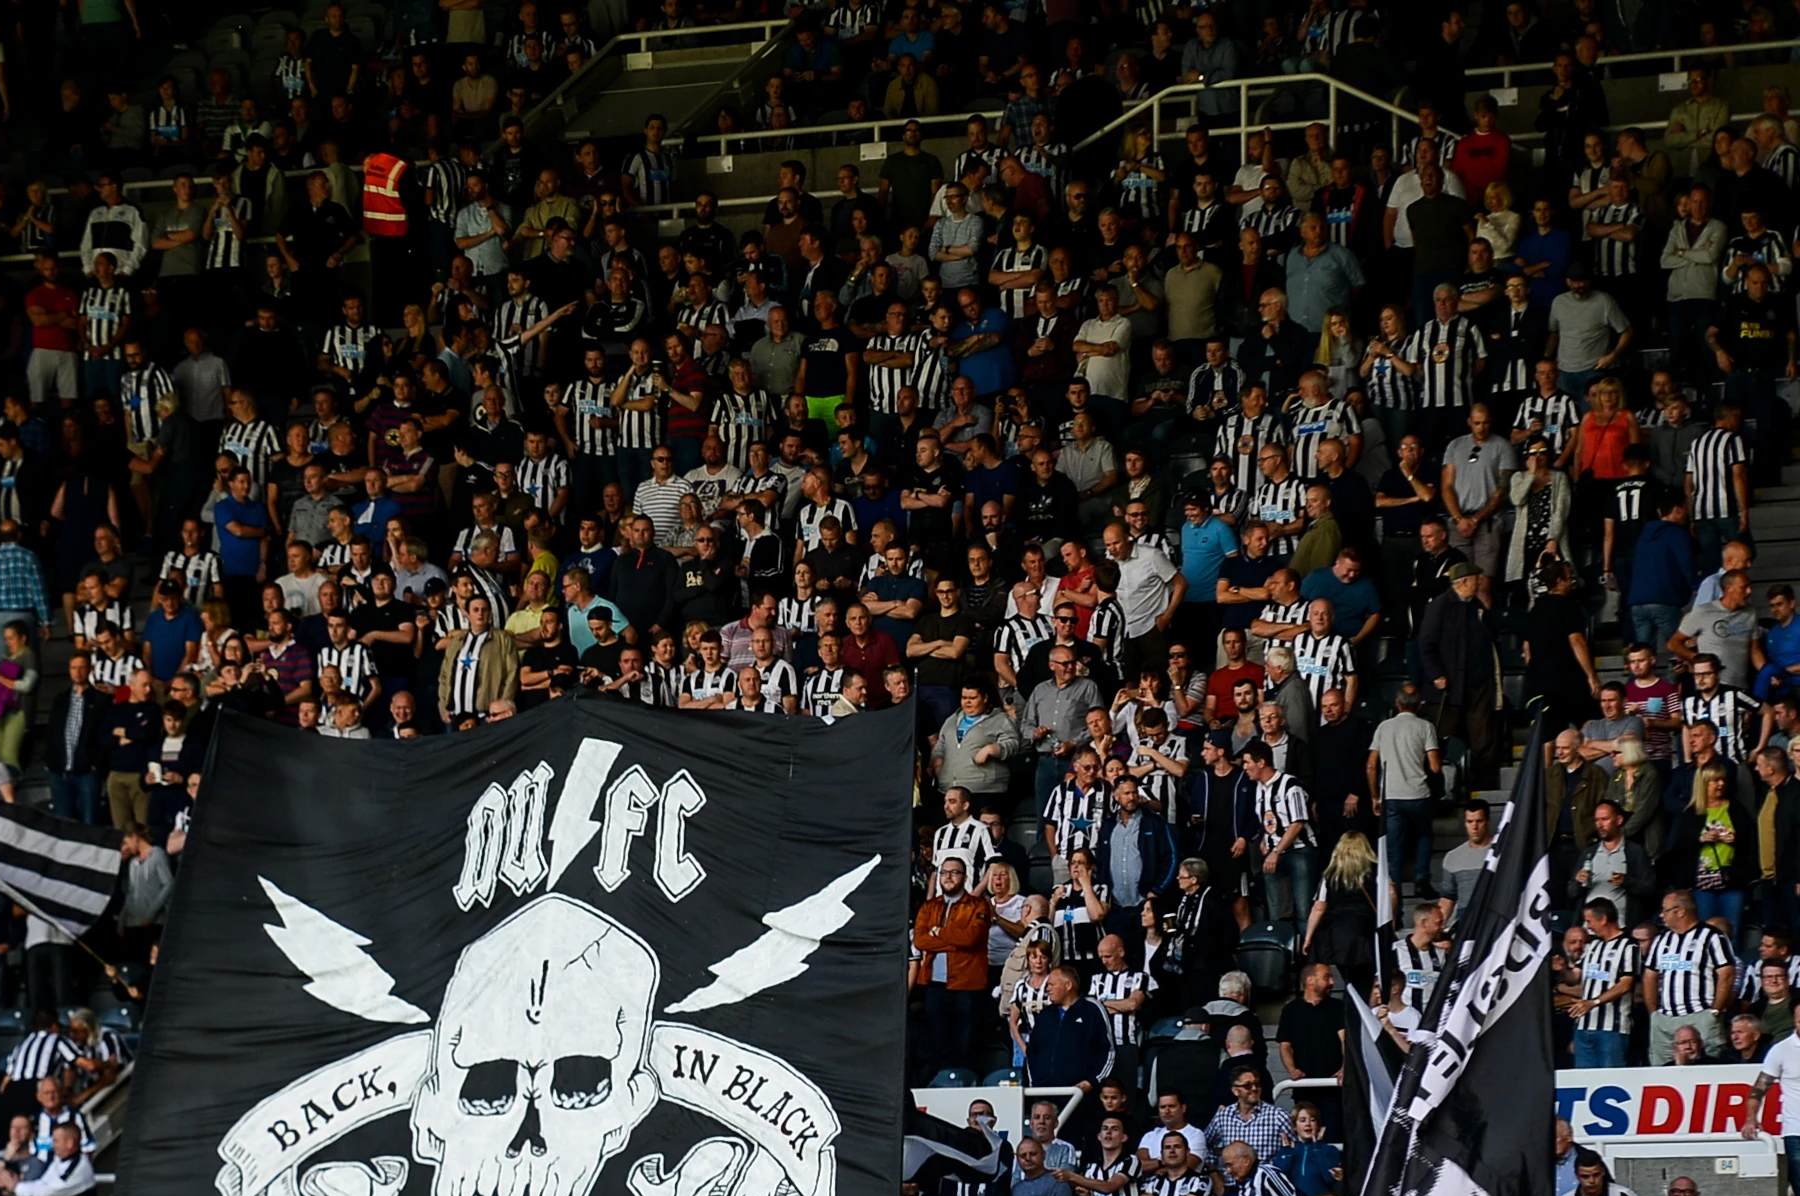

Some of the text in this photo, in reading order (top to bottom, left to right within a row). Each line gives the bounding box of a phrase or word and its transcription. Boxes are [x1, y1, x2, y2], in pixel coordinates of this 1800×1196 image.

[1616, 488, 1641, 521] 11
[267, 1066, 397, 1152] BACK,
[673, 1043, 817, 1160] IN BLACK
